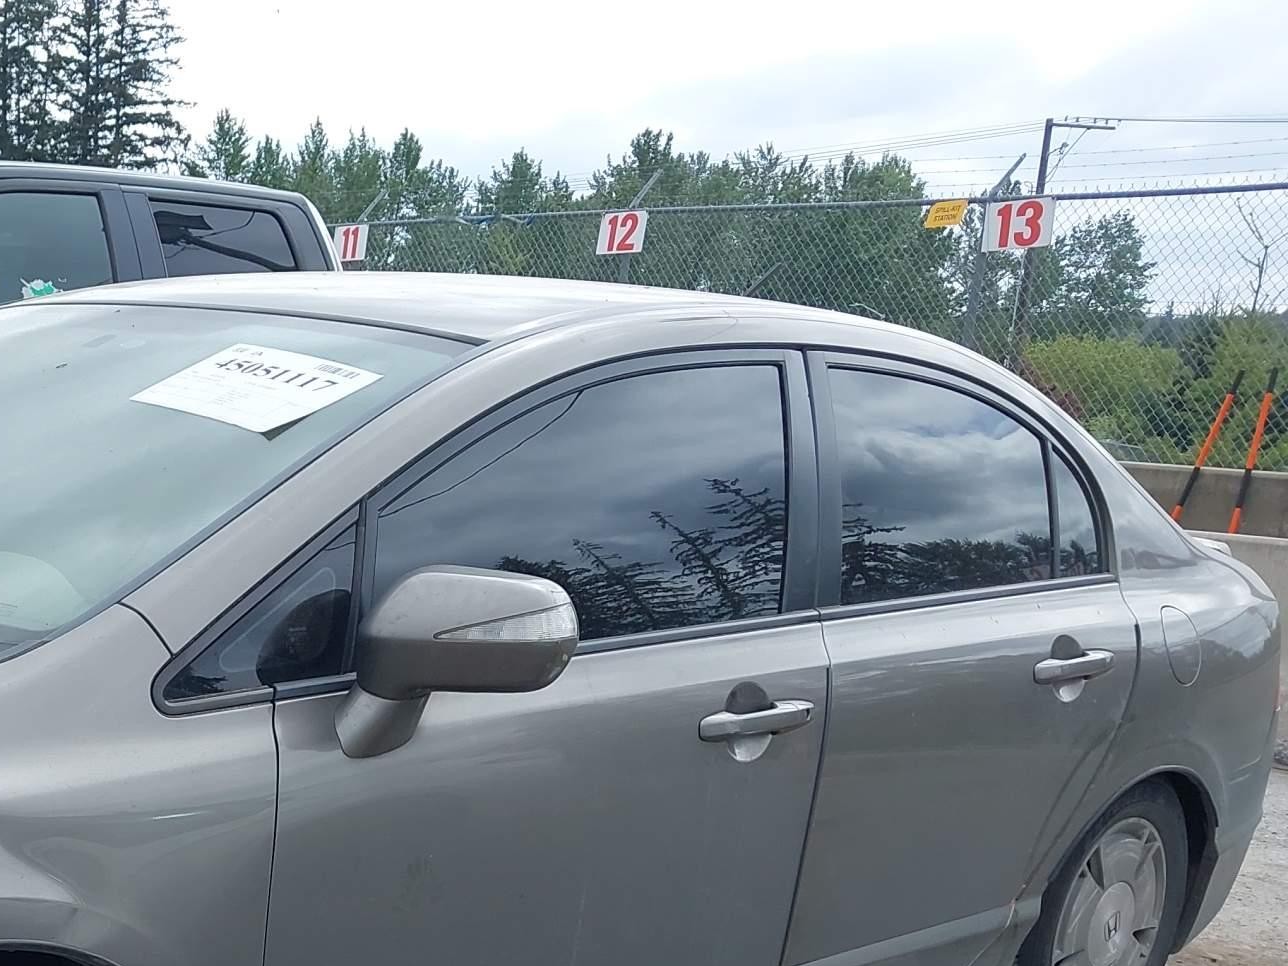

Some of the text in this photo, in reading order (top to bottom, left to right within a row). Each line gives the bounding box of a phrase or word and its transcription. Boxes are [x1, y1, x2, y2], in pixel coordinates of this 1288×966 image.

[607, 213, 638, 251] 12
[996, 201, 1043, 248] 13
[342, 226, 360, 259] 11
[215, 358, 339, 391] 45051117
